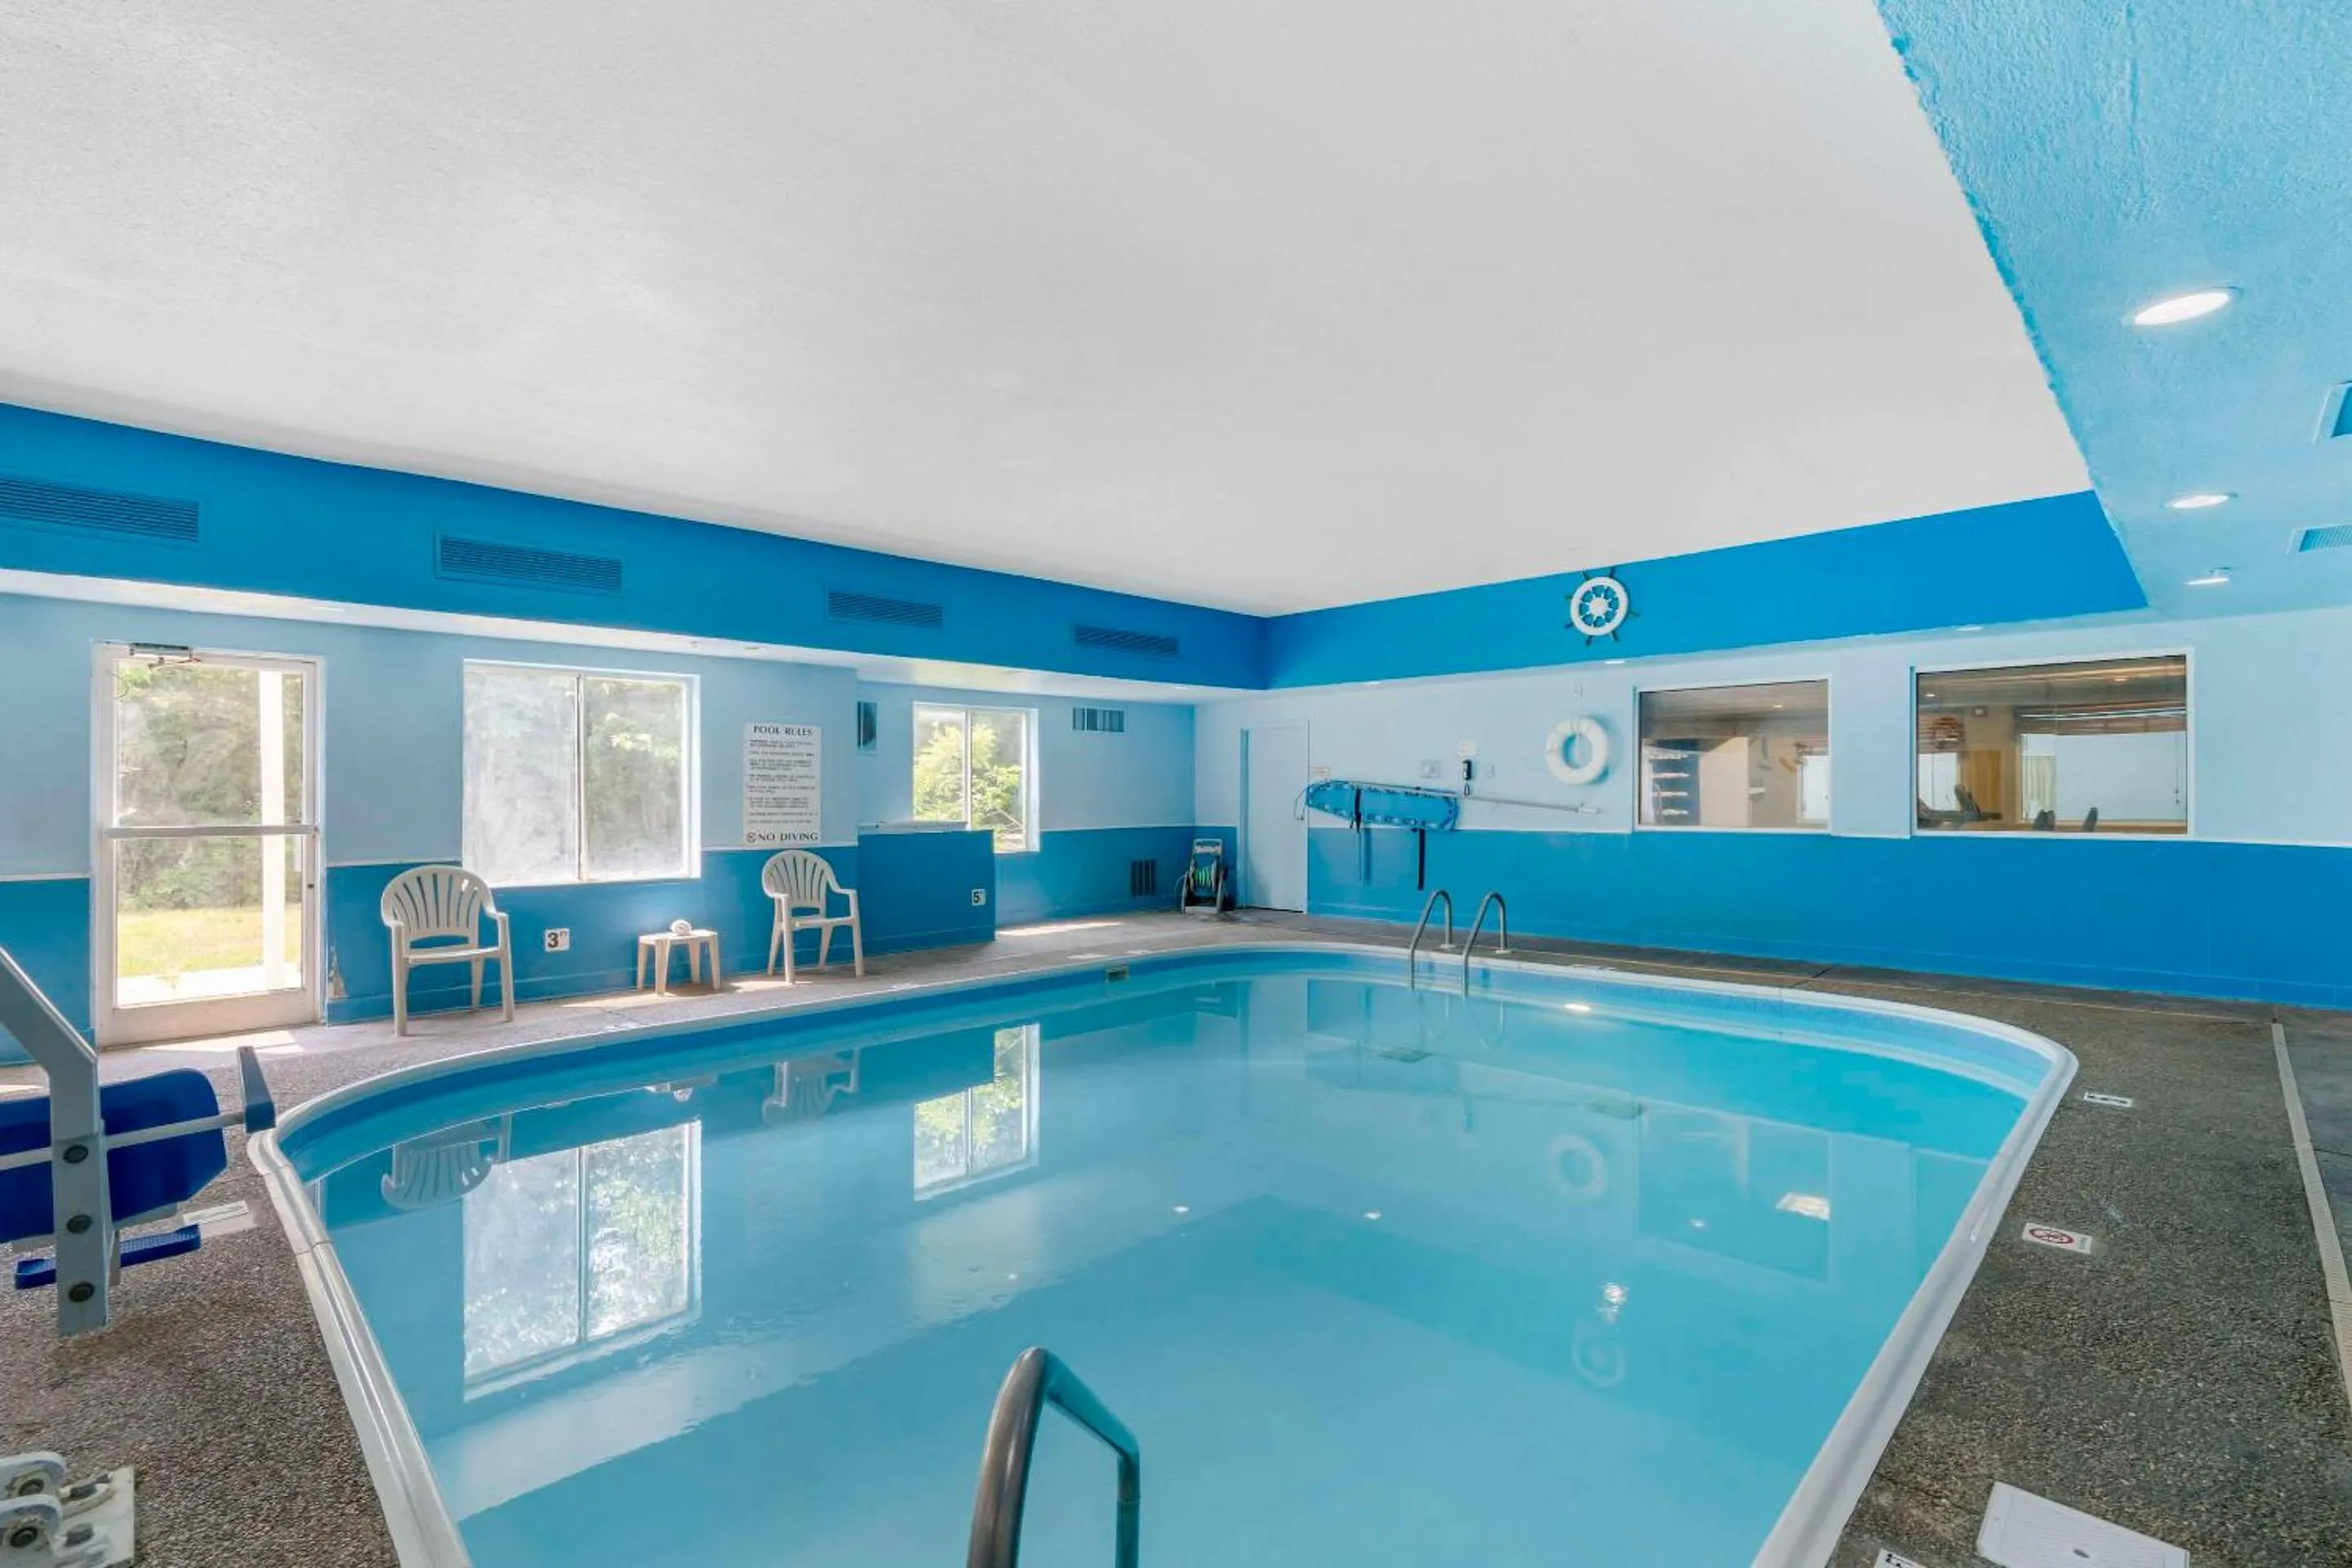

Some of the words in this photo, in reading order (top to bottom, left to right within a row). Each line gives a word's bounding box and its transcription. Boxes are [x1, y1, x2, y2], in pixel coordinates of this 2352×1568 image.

[754, 725, 781, 735] POOL
[785, 727, 813, 737] RULES
[758, 833, 775, 841] NO
[780, 832, 818, 841] DIVING
